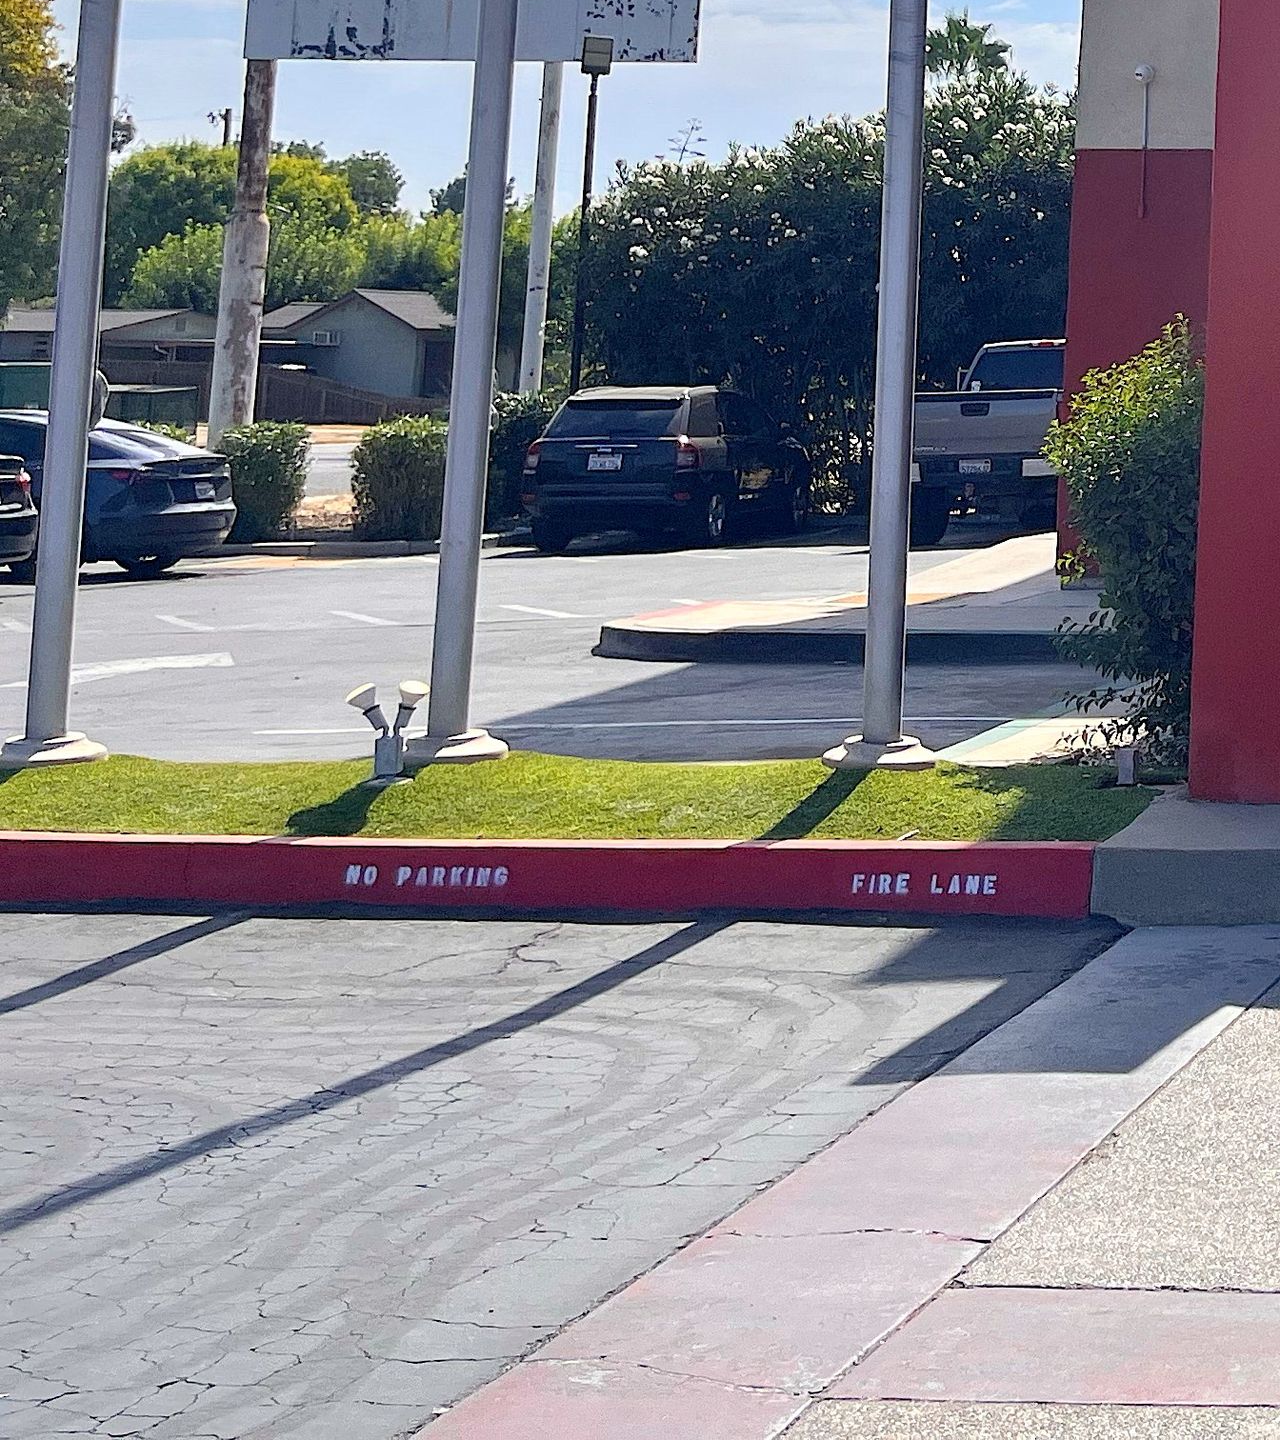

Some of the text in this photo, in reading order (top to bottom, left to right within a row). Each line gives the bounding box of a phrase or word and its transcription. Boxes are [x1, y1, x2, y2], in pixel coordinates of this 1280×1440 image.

[345, 864, 509, 887] NO PARKING
[852, 873, 998, 895] FIRE LANE
